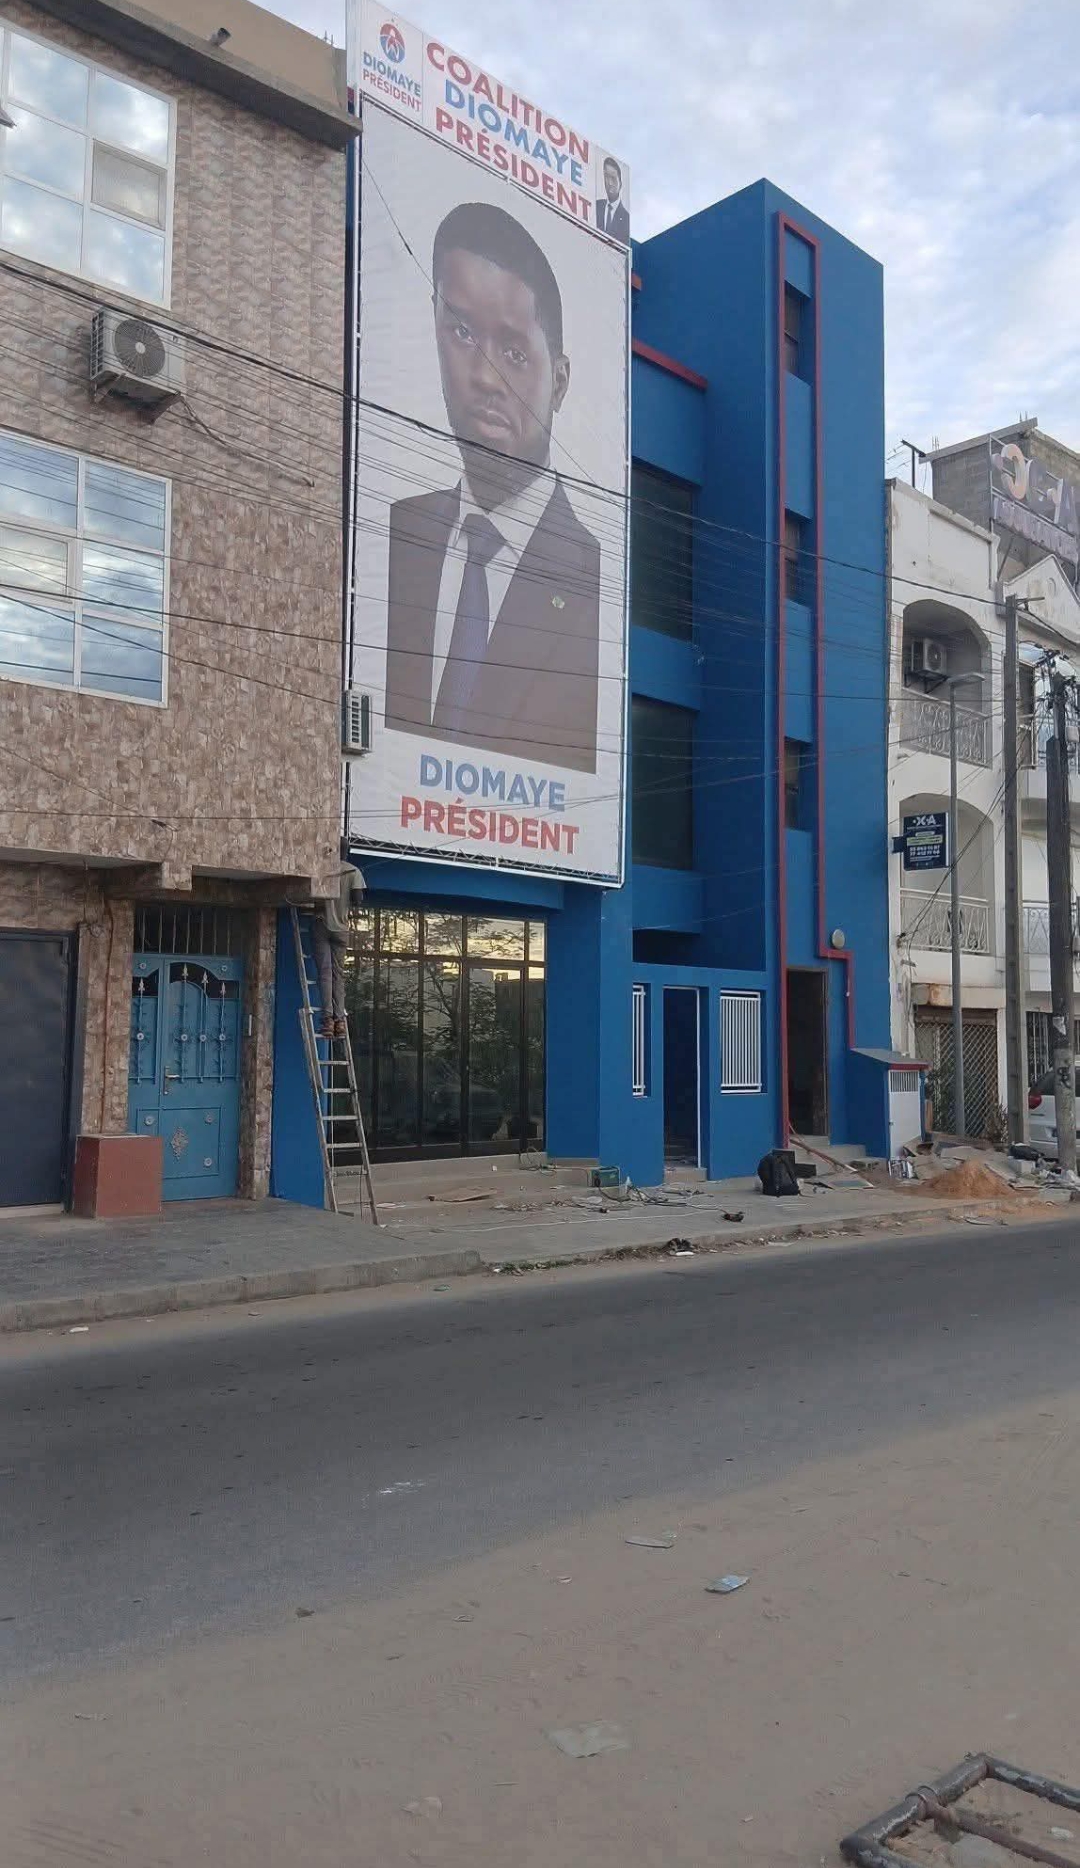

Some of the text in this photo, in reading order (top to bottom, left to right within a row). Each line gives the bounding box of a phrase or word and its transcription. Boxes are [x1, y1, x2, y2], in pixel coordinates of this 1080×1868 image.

[362, 68, 422, 112] PRÉSIDENT
[363, 51, 421, 97] DIOMAYE
[426, 42, 589, 163] COALITION
[445, 79, 582, 186] DIOMAYE
[436, 107, 592, 221] PRÉSIDENT
[420, 754, 566, 812] DIOMAYE
[401, 796, 579, 854] PRÉSIDENT
